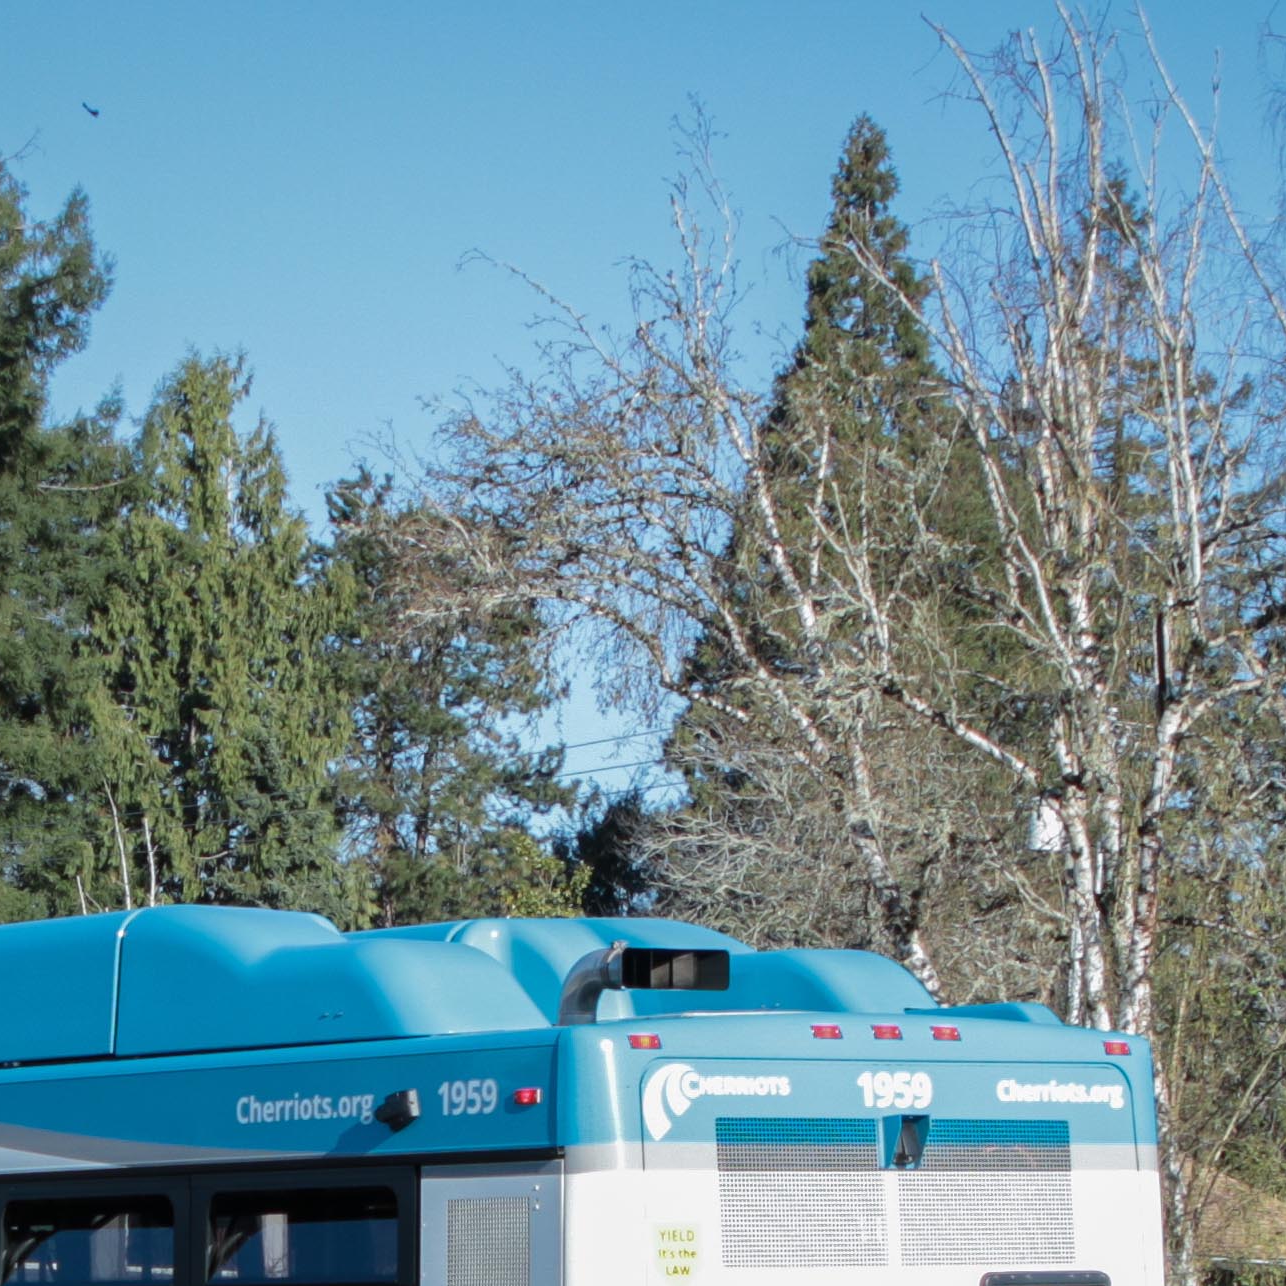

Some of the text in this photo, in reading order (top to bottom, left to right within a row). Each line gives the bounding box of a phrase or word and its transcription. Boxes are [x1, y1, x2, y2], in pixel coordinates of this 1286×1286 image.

[438, 1078, 498, 1116] 1959
[680, 1070, 792, 1098] CHERRIOTS
[857, 1070, 934, 1109] 1959
[996, 1078, 1125, 1110] Cherriots.org
[236, 1093, 374, 1125] Cherriots.org
[658, 1229, 695, 1242] YIELD
[678, 1248, 697, 1259] the
[665, 1265, 690, 1276] LAW
